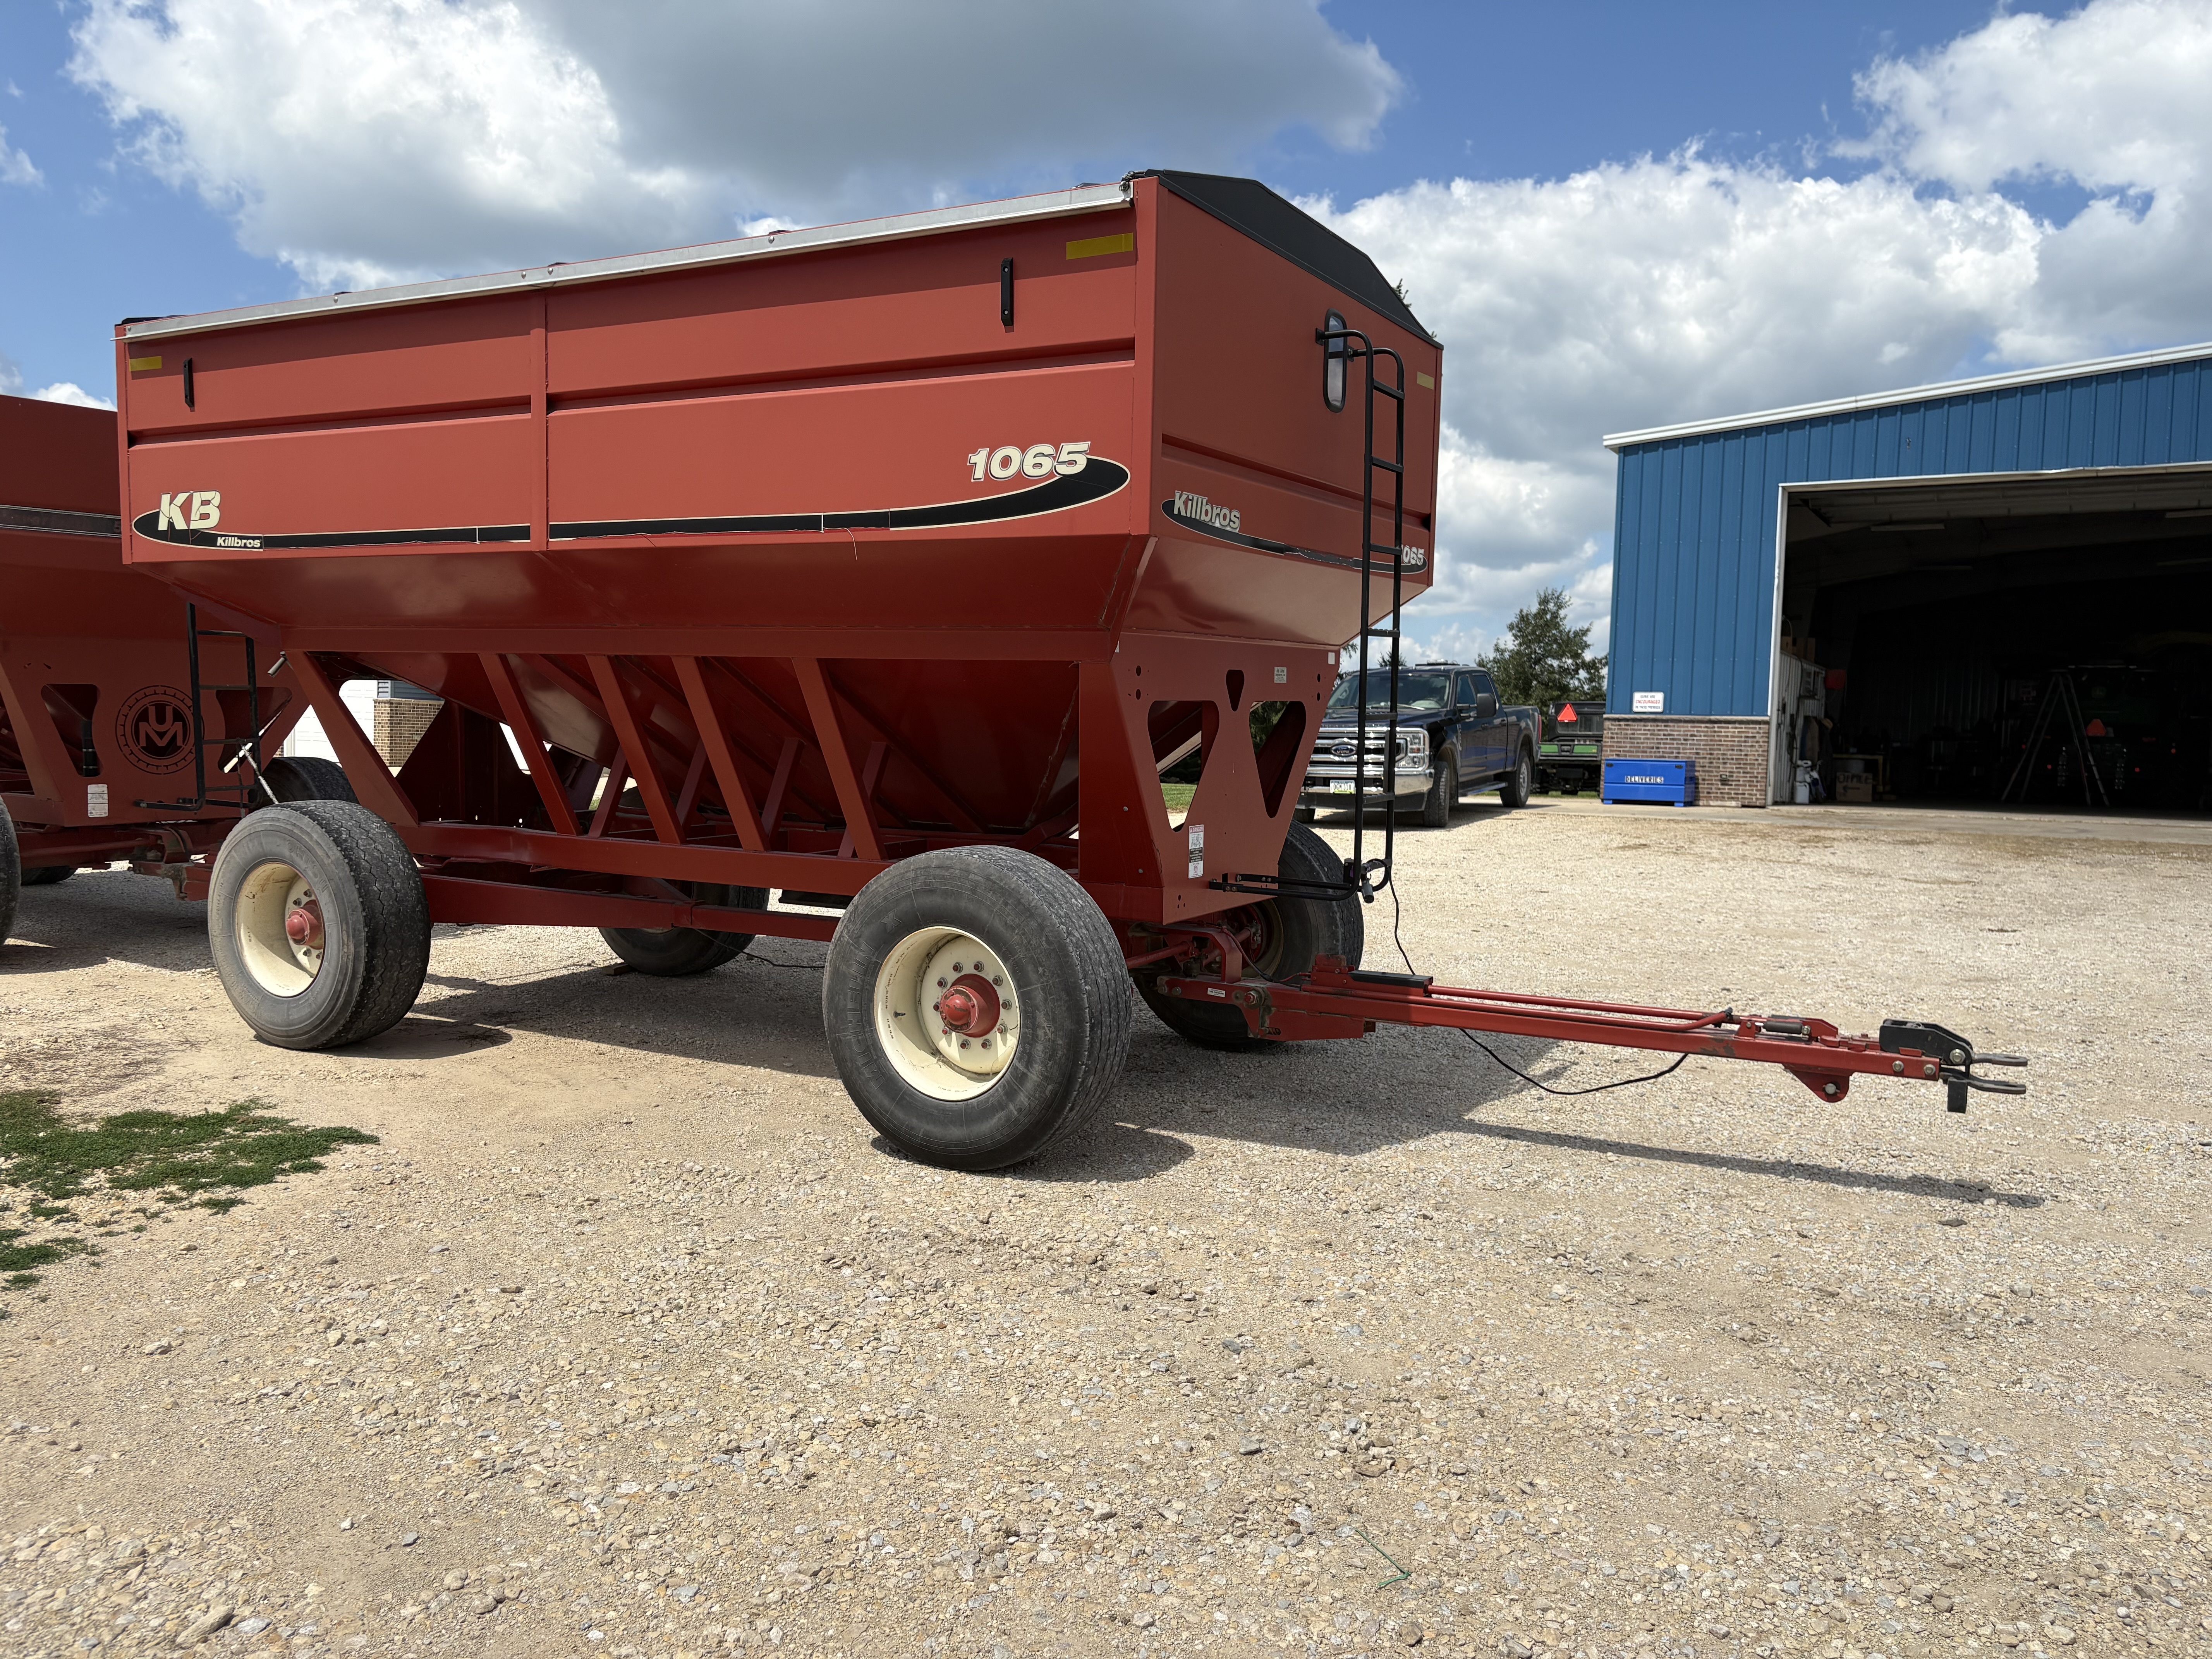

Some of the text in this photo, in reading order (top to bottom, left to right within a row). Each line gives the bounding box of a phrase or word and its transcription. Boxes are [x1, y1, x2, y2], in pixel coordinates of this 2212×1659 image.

[967, 441, 1091, 482] 1065
[158, 490, 221, 531] KB
[1173, 490, 1240, 529] Killbros
[217, 537, 261, 547] Killbros
[847, 941, 886, 1090] MICHELIN
[880, 909, 902, 933] X
